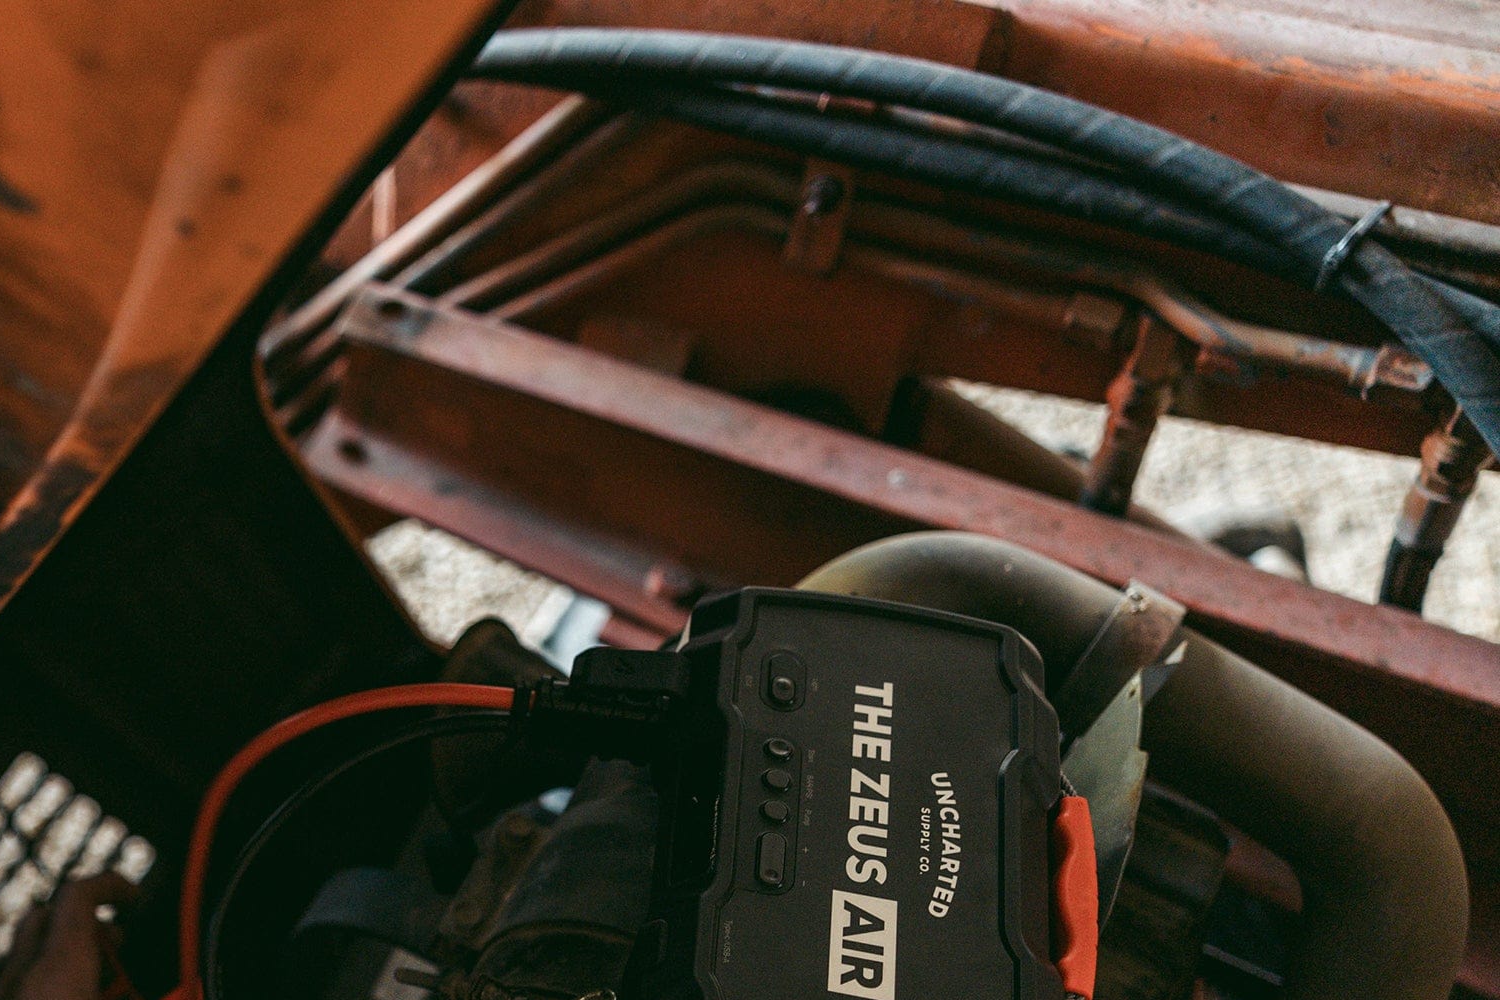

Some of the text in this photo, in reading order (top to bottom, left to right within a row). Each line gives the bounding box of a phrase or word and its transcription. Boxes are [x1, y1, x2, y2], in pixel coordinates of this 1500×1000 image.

[840, 681, 894, 990] THE ZEUS AIR
[918, 807, 931, 875] SUPPLY CO.
[927, 772, 963, 918] UNCHARTED
